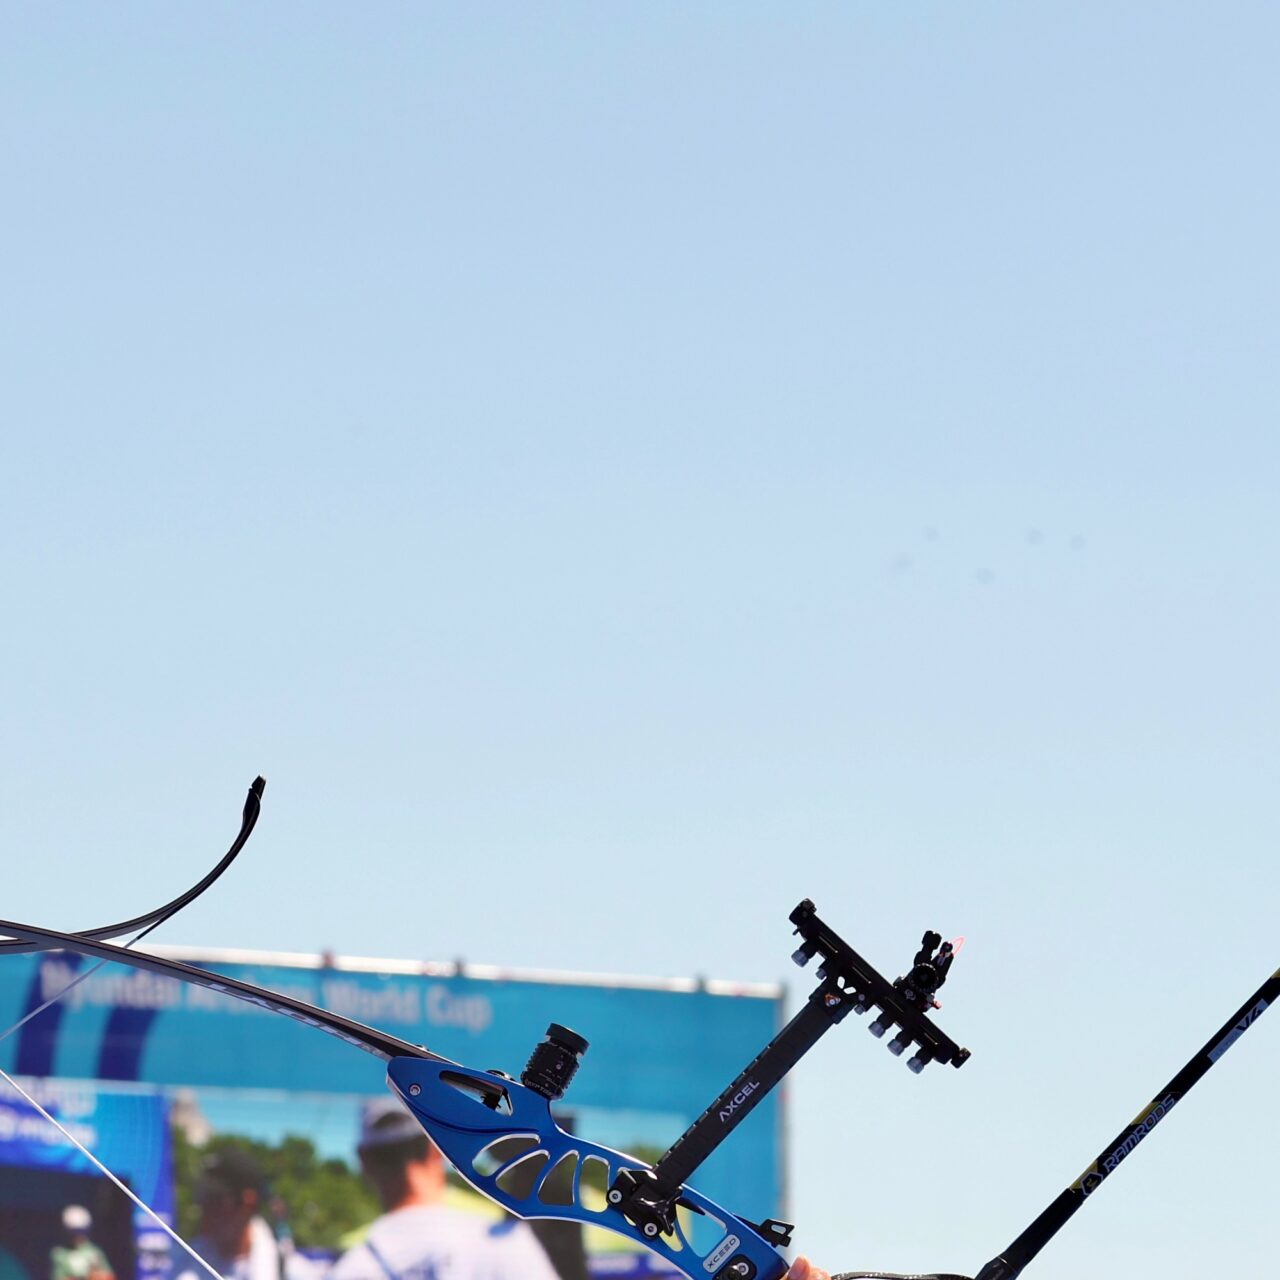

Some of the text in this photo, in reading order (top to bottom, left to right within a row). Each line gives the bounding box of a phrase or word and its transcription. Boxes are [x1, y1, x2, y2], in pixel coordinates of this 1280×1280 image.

[427, 987, 494, 1034] Cup
[719, 1081, 760, 1122] AXCEL
[1103, 1093, 1175, 1173] RAMRODS
[706, 1237, 737, 1269] XCEED
